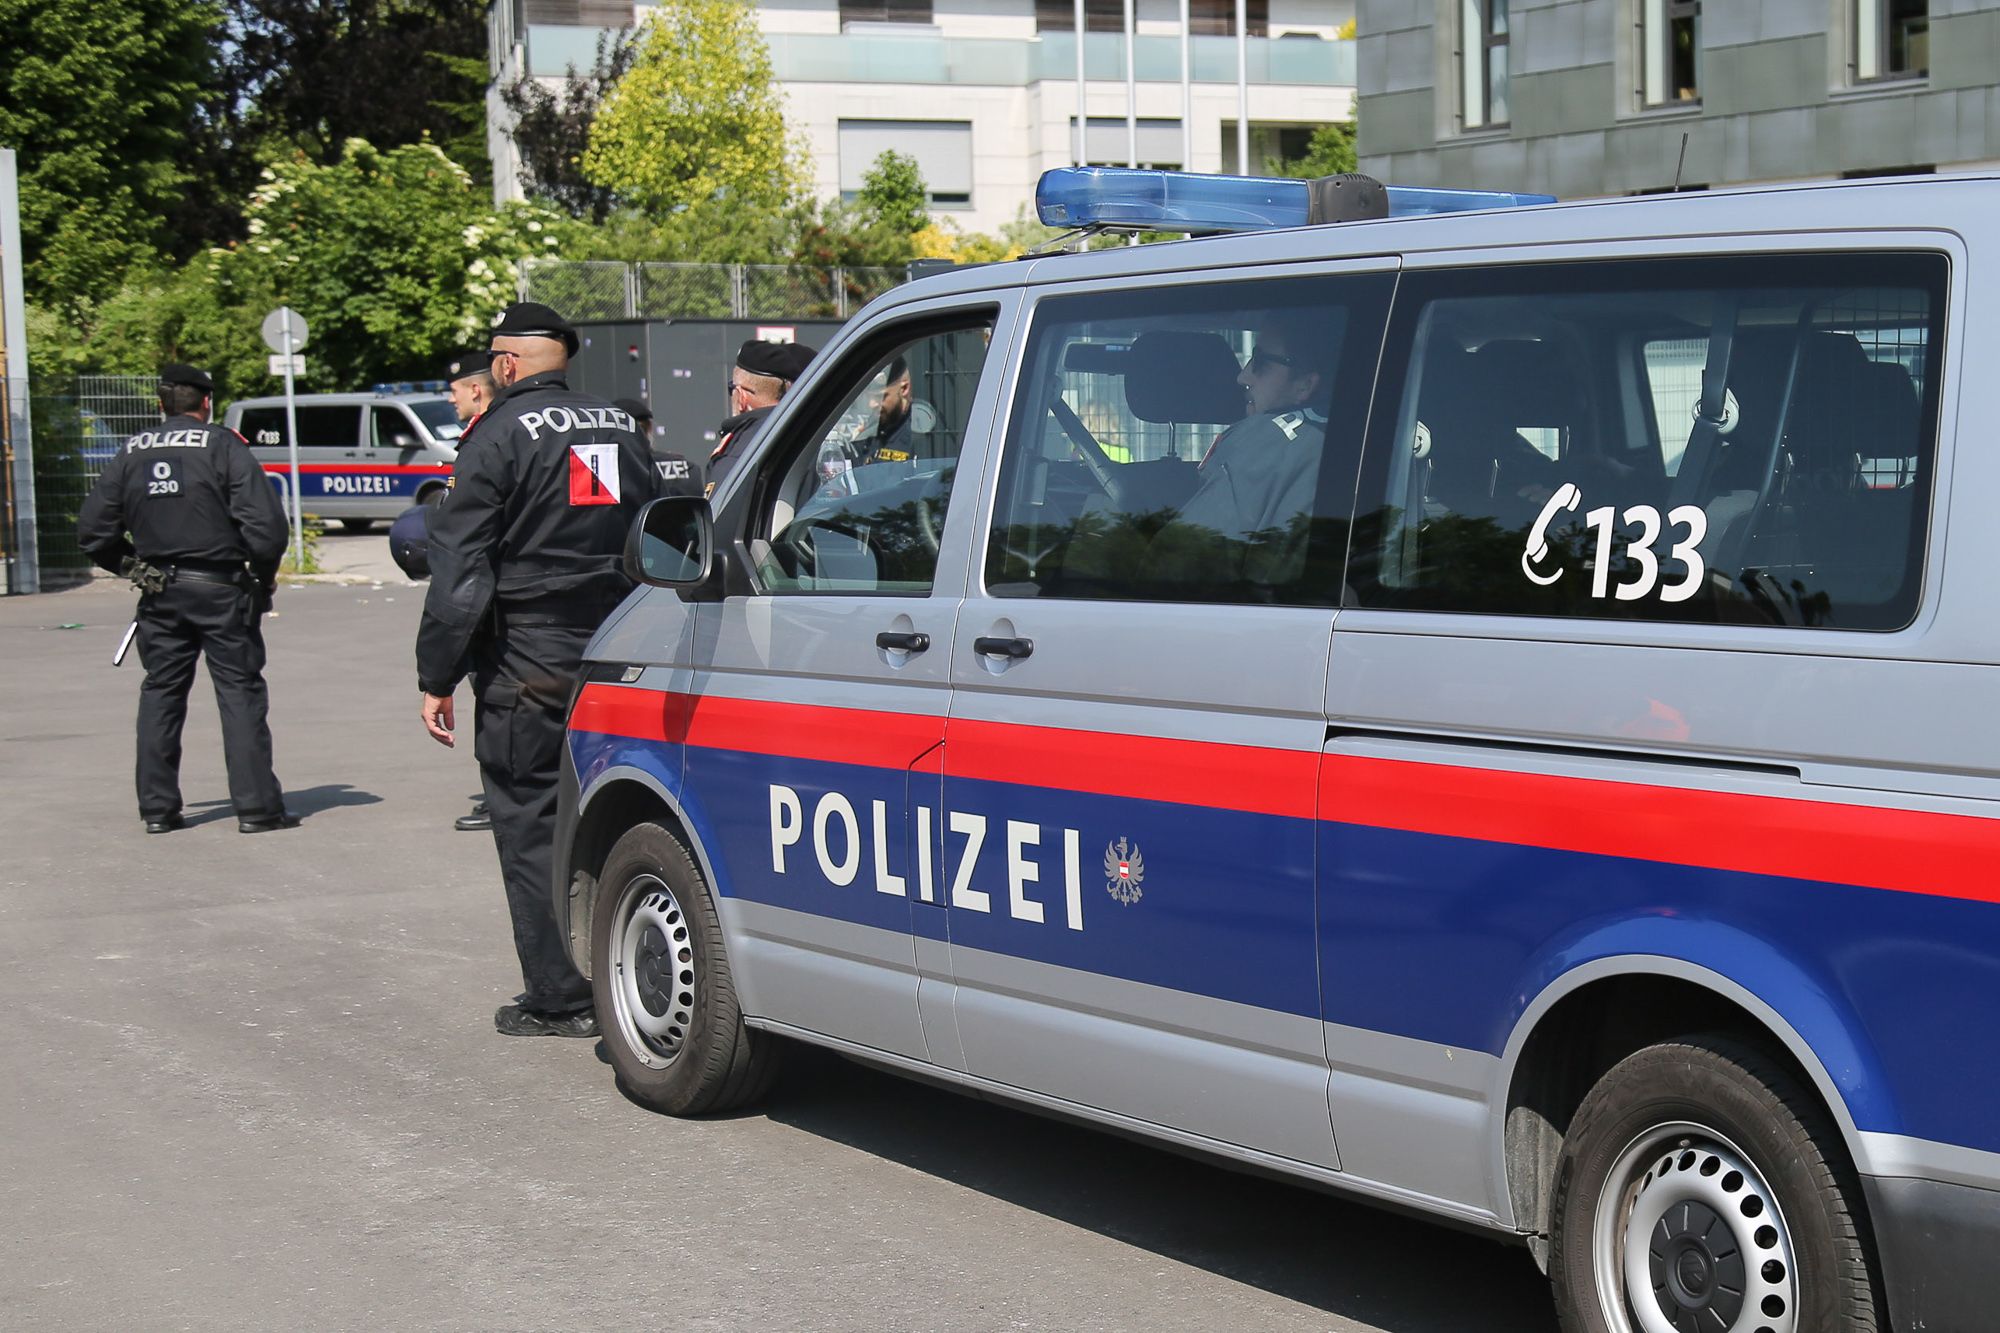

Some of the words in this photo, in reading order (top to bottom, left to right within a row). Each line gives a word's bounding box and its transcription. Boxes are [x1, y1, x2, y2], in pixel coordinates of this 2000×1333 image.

[517, 406, 636, 441] POLIZEI
[126, 429, 210, 454] POLIZEI
[654, 460, 690, 480] IZEI
[148, 480, 179, 495] 230
[322, 476, 391, 494] POLIZEI
[1585, 504, 1708, 603] 133
[769, 784, 1084, 931] POLIZEI
